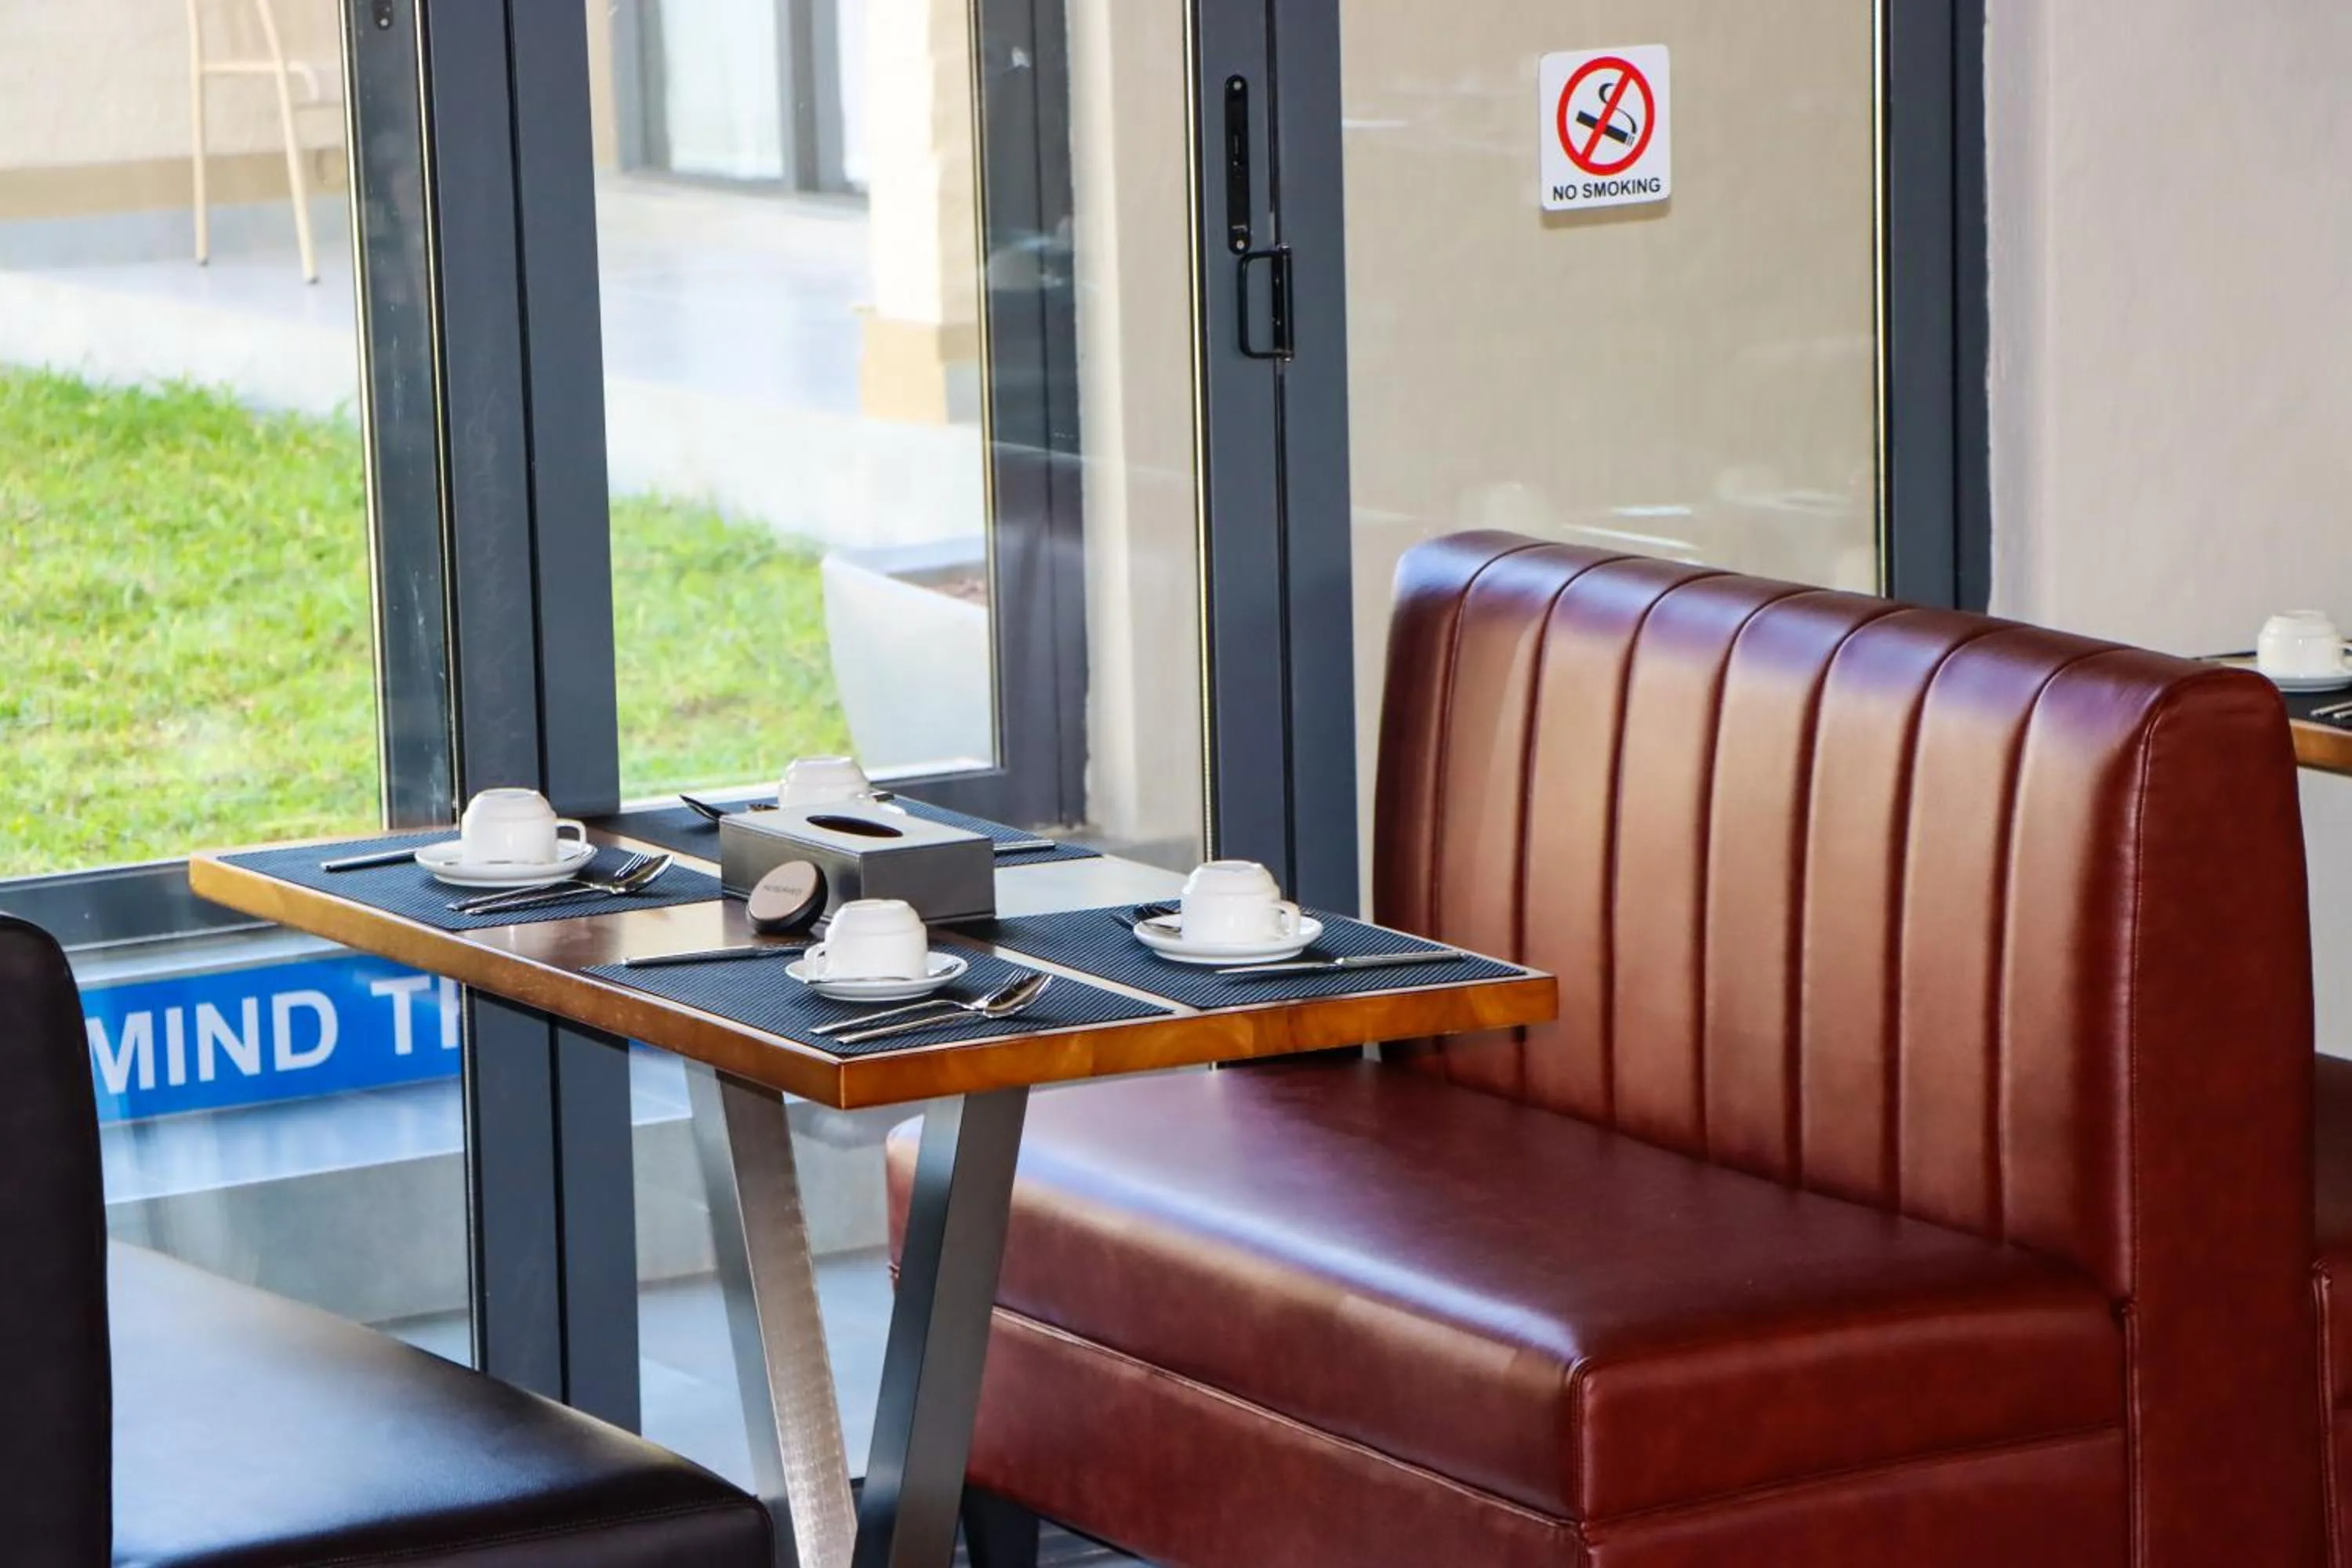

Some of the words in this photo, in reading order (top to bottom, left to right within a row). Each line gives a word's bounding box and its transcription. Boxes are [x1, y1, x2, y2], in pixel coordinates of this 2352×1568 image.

[1553, 185, 1577, 201] NO
[1582, 177, 1661, 198] SMOKING
[85, 990, 339, 1094] MIND
